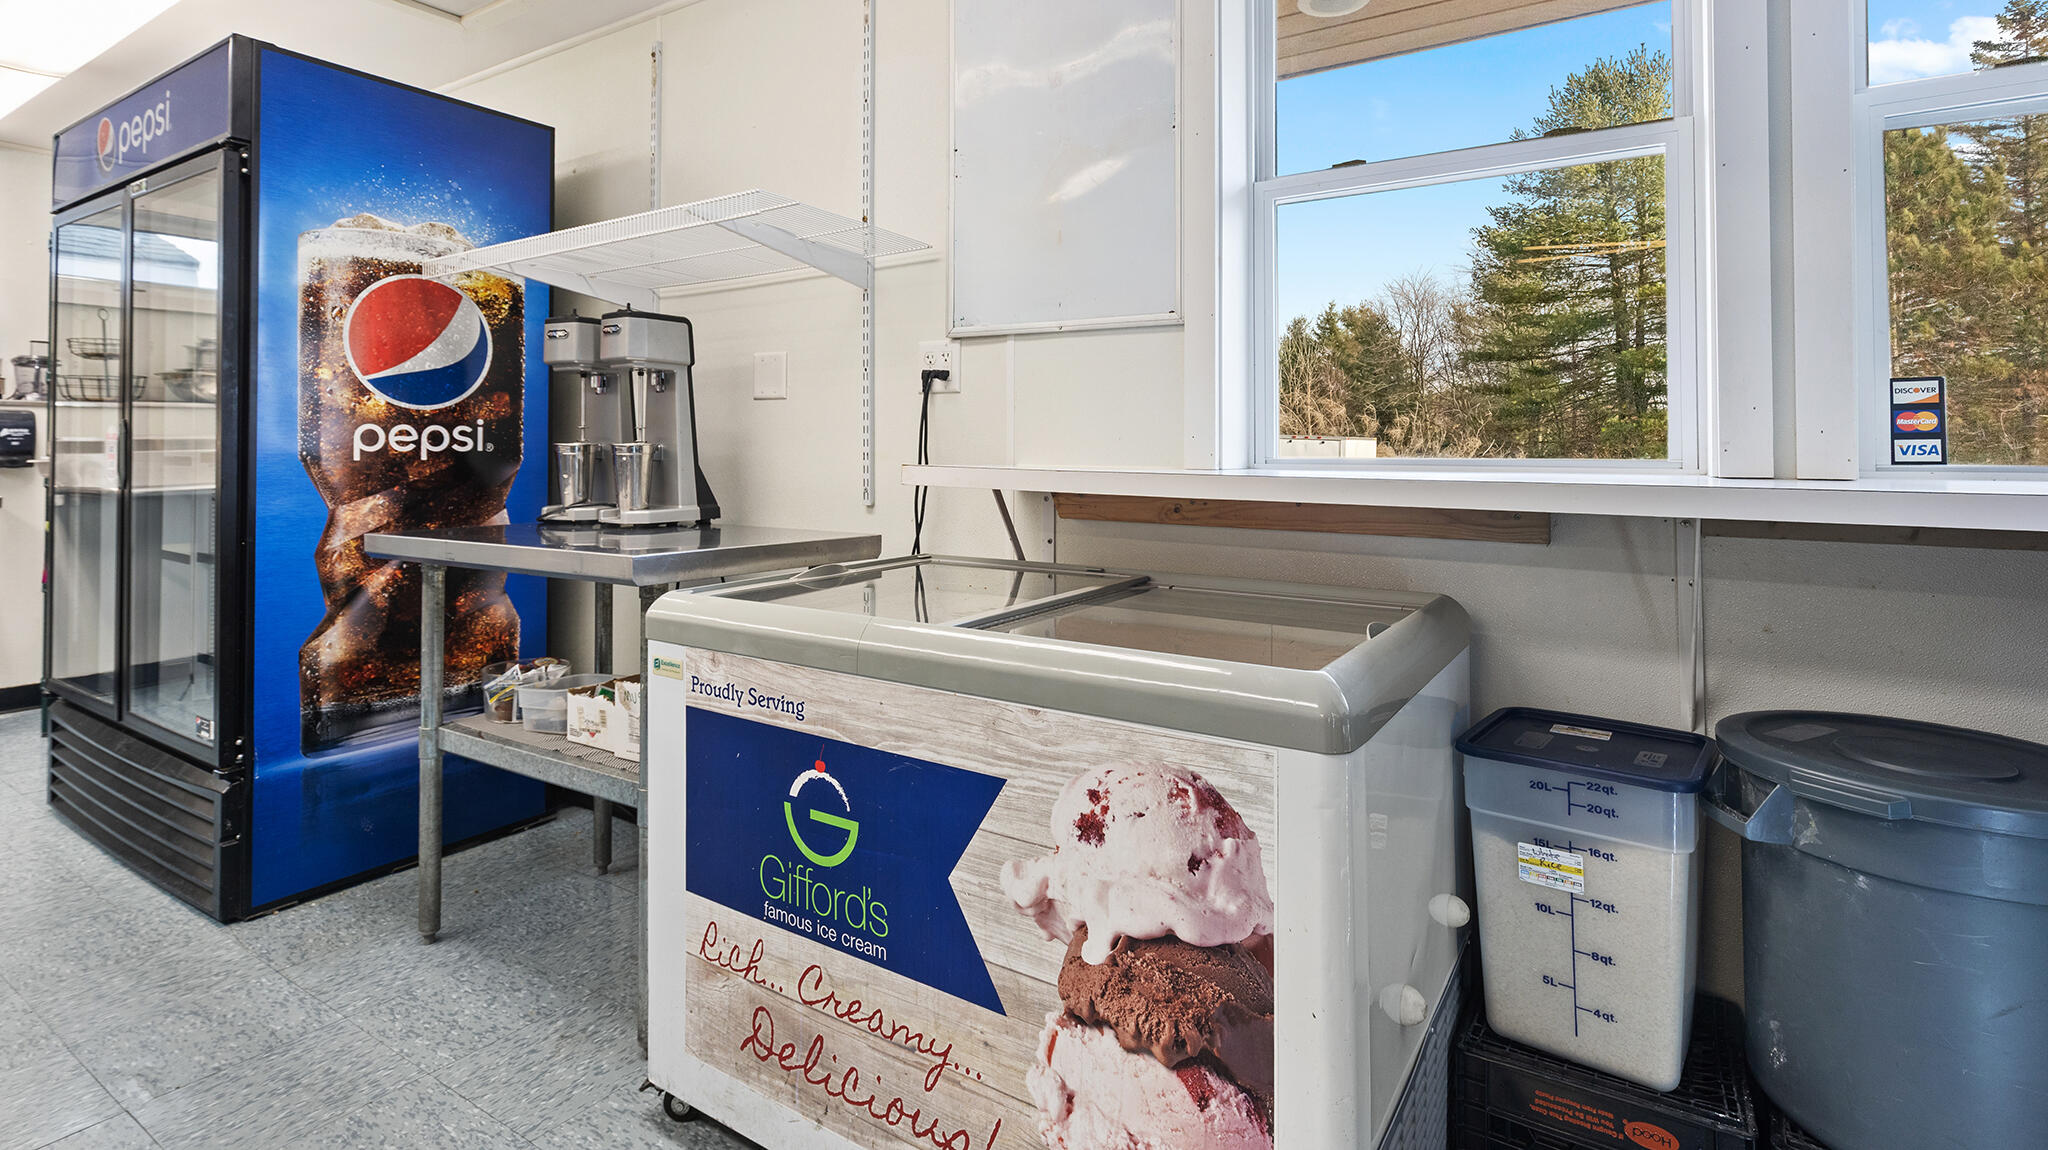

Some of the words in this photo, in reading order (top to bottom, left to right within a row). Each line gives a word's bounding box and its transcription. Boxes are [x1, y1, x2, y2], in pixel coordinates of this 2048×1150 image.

[119, 90, 171, 164] pepsi
[1897, 444, 1940, 456] VISA
[691, 675, 744, 707] Proudly
[747, 687, 805, 721] Serving
[1529, 780, 1552, 792] 20L
[1533, 838, 1553, 849] 15L
[760, 854, 888, 937] Gifford's
[1535, 902, 1555, 915] 10L
[764, 901, 812, 933] famous
[817, 920, 837, 942] ice
[841, 933, 887, 960] cream
[1542, 975, 1558, 987] 5L
